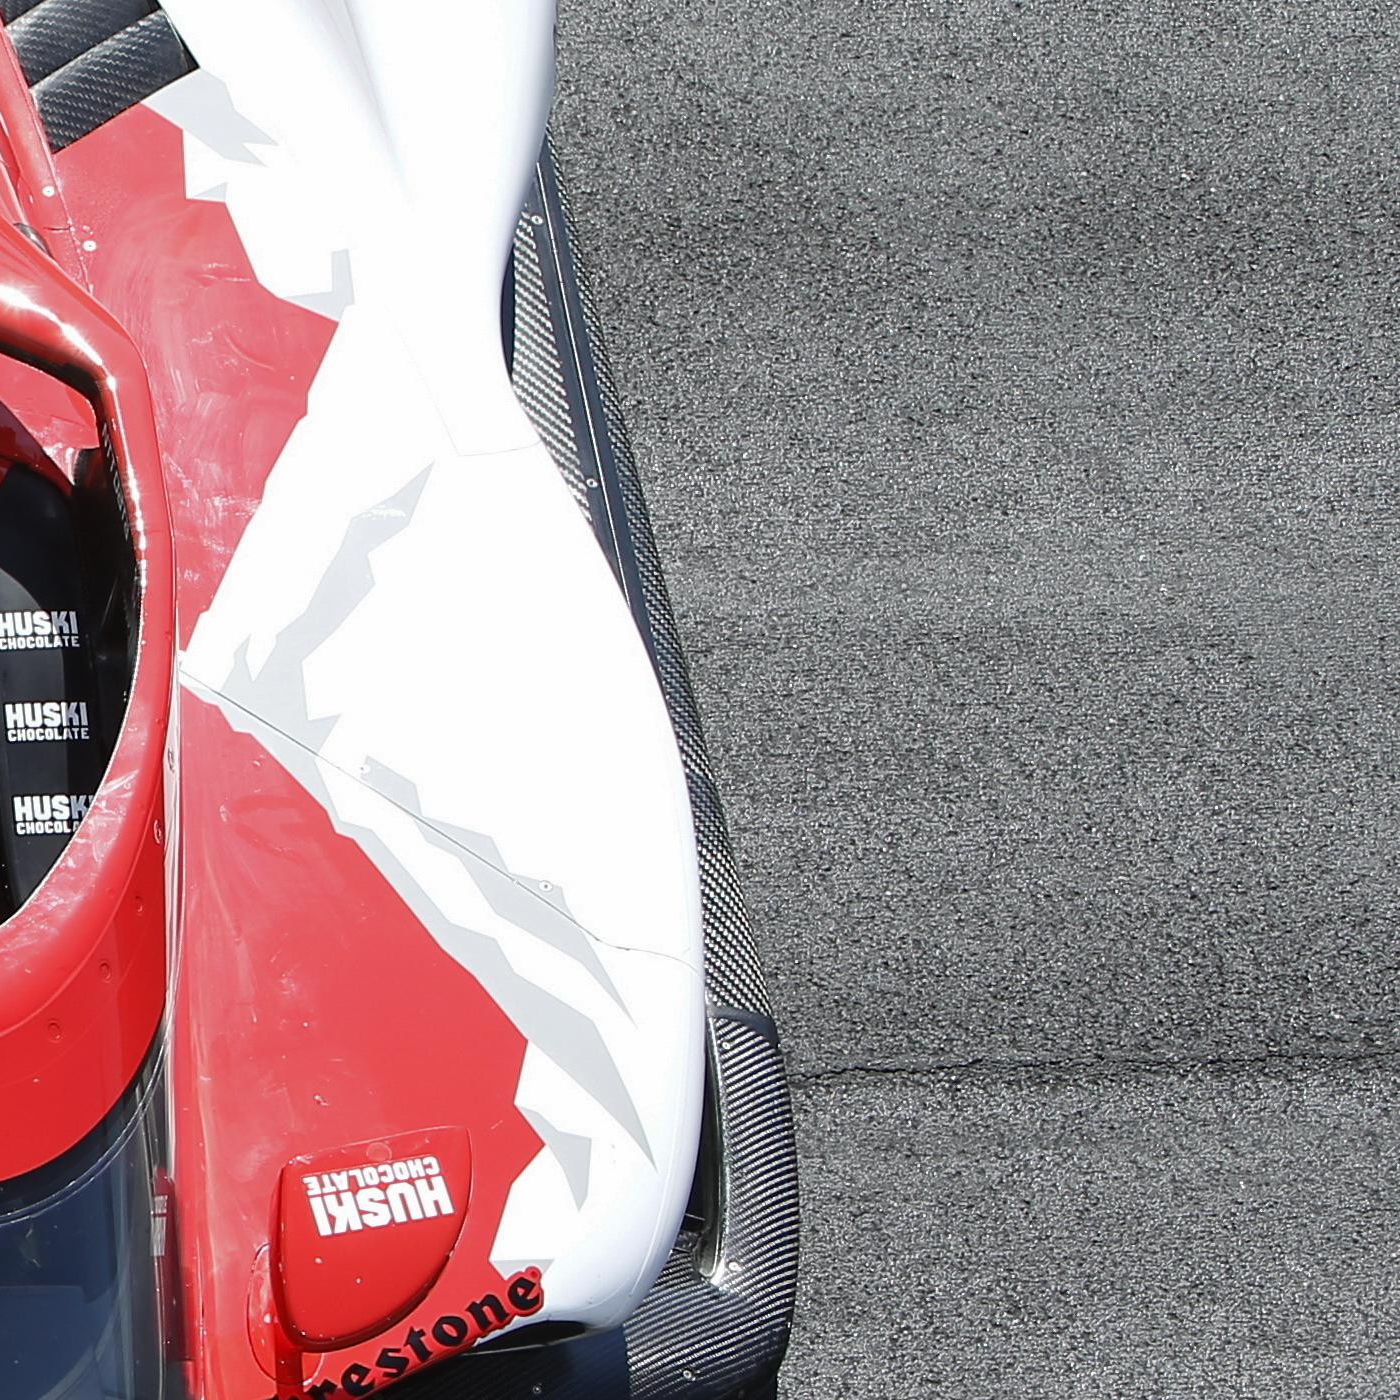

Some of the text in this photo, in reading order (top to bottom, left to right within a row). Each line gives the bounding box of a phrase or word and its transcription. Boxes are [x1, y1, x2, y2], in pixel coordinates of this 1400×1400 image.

[5, 702, 89, 729] HUSKI
[7, 727, 90, 743] CHOCOLATE
[303, 1155, 441, 1197] CHOCOLATE
[308, 1174, 455, 1237] HUSKI
